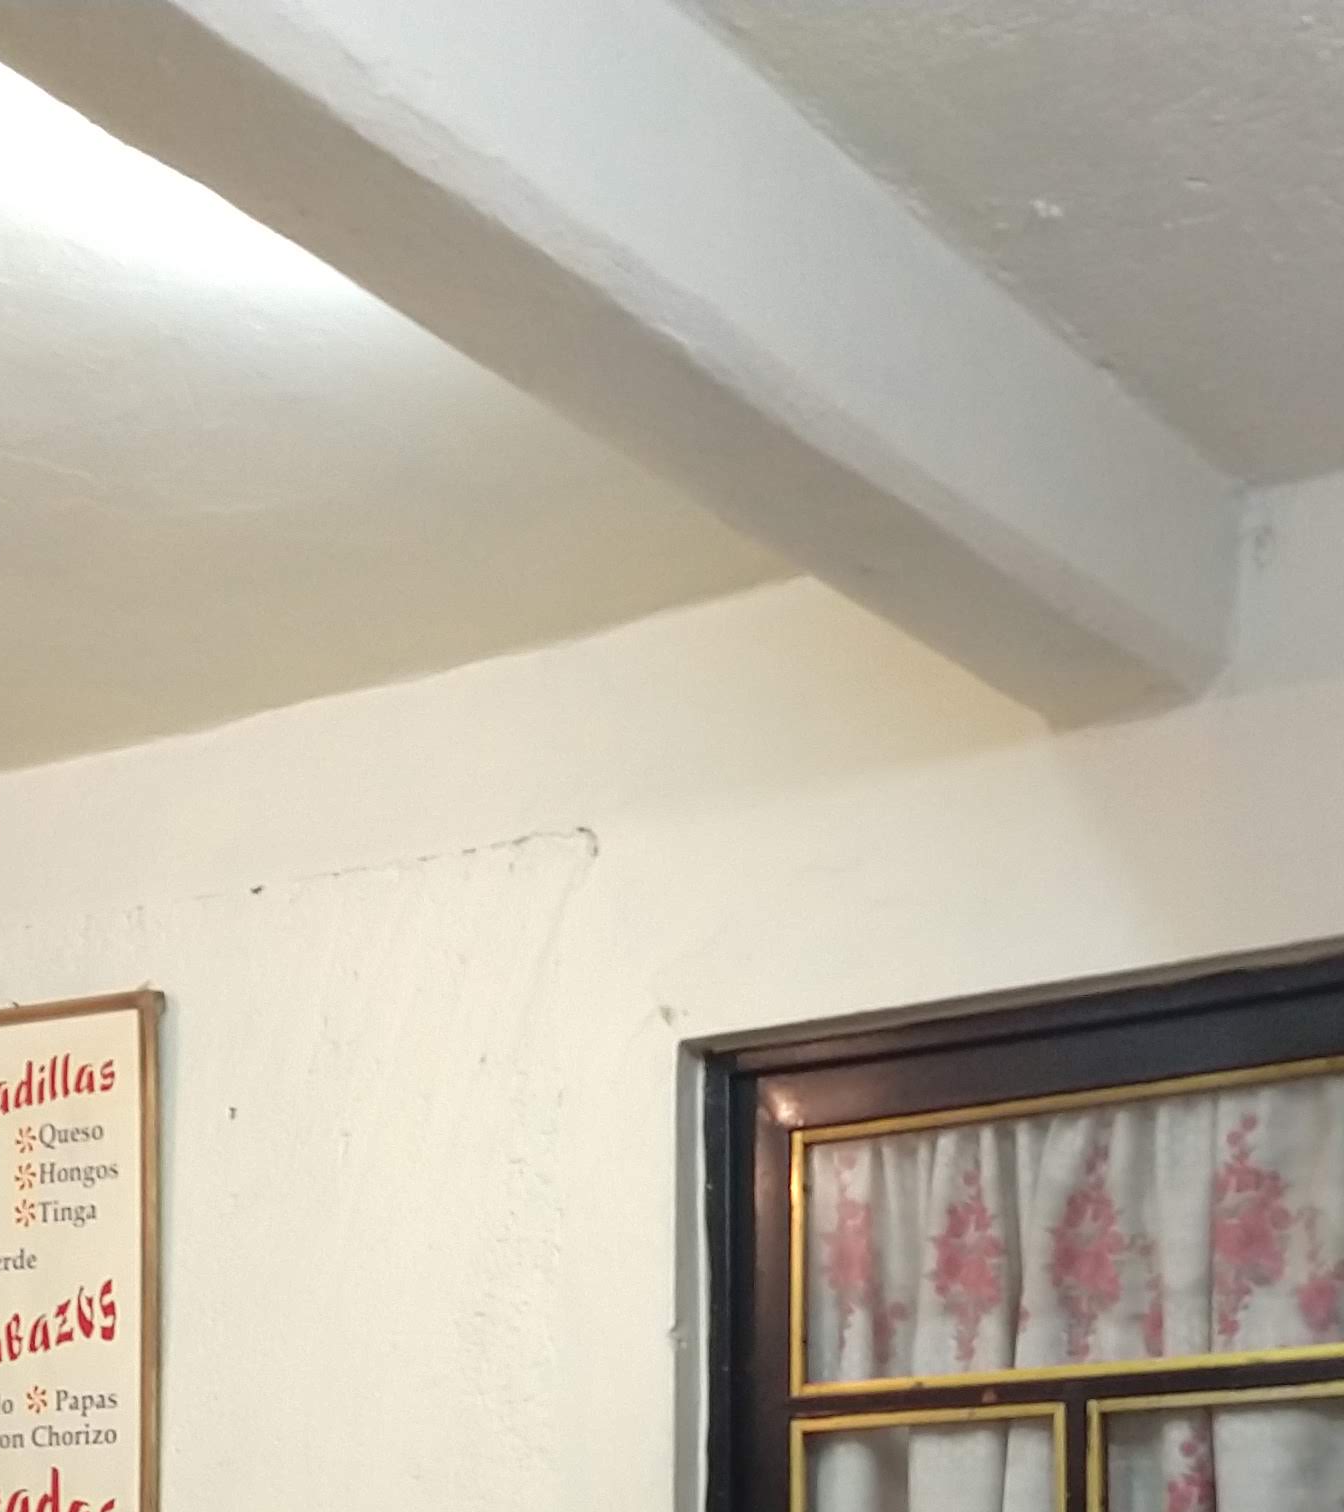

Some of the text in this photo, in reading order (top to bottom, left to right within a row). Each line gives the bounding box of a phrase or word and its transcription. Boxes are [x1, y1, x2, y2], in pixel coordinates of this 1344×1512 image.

[38, 1123, 105, 1150] Queso
[39, 1161, 119, 1188] Hongos
[39, 1201, 97, 1228] Tinga
[55, 1389, 118, 1417] Papas
[31, 1424, 118, 1448] Chorizo
